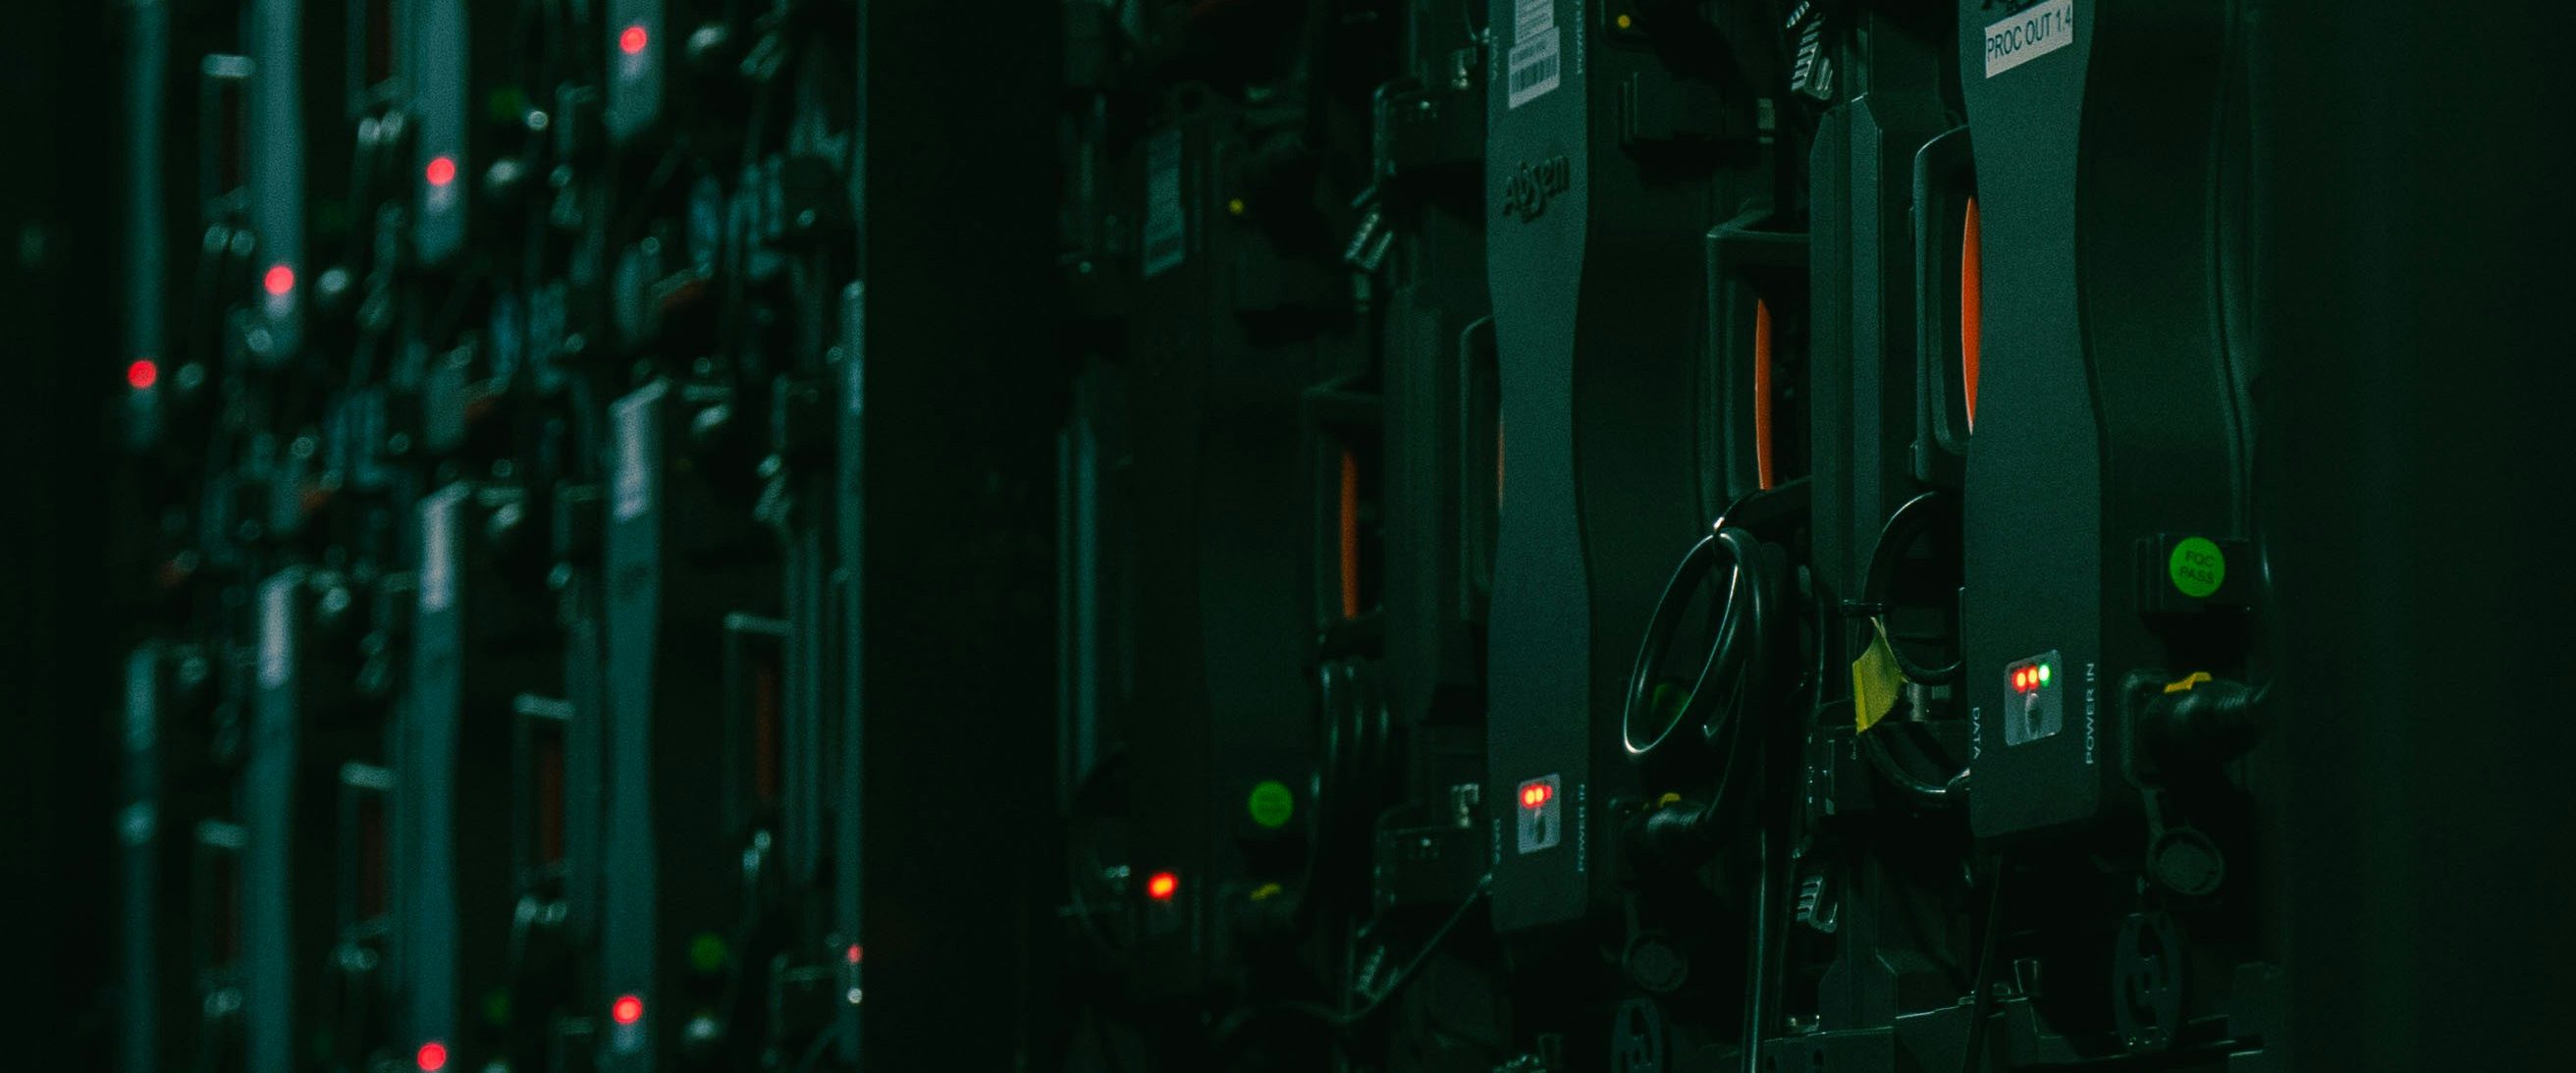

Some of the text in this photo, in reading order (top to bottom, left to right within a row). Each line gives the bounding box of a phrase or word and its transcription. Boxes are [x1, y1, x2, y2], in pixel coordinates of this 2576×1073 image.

[1987, 26, 2022, 62] PROC
[2025, 12, 2052, 45] OUT
[2057, 4, 2071, 32] 1.4
[2179, 565, 2216, 585] PASS
[1972, 707, 1981, 760] DATA
[2085, 663, 2095, 764] POWER IN
[1578, 783, 1585, 801] IN
